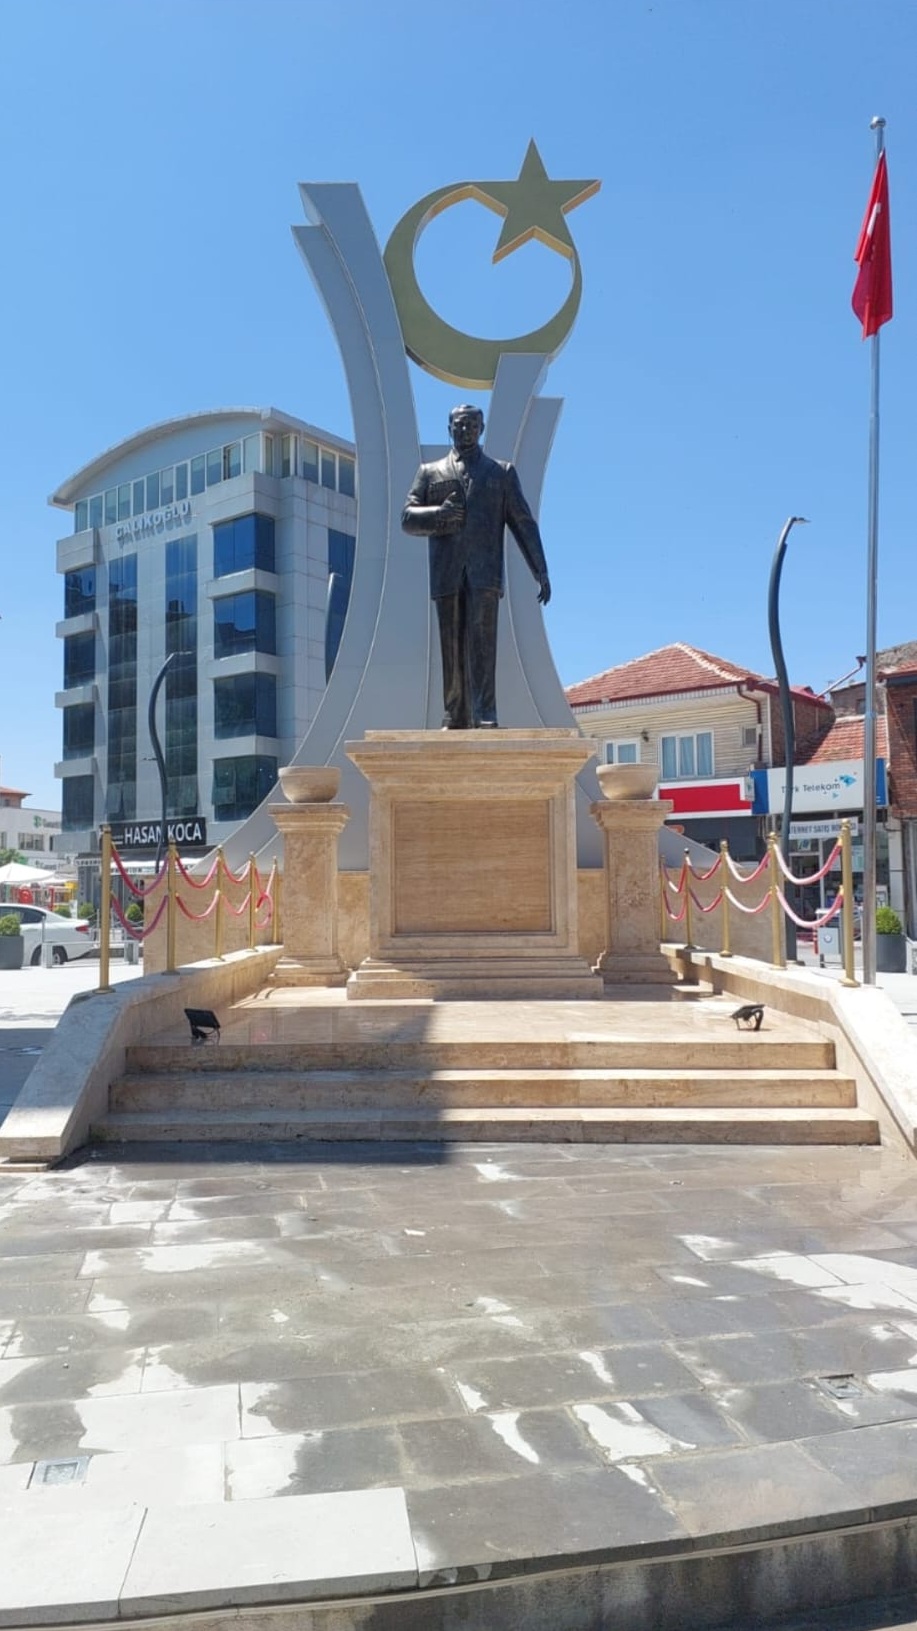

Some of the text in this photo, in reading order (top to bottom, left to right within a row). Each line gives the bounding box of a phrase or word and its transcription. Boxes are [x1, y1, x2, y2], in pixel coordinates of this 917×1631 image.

[802, 783, 841, 792] Telekom
[124, 826, 165, 845] HASAN
[167, 823, 203, 842] KOCA
